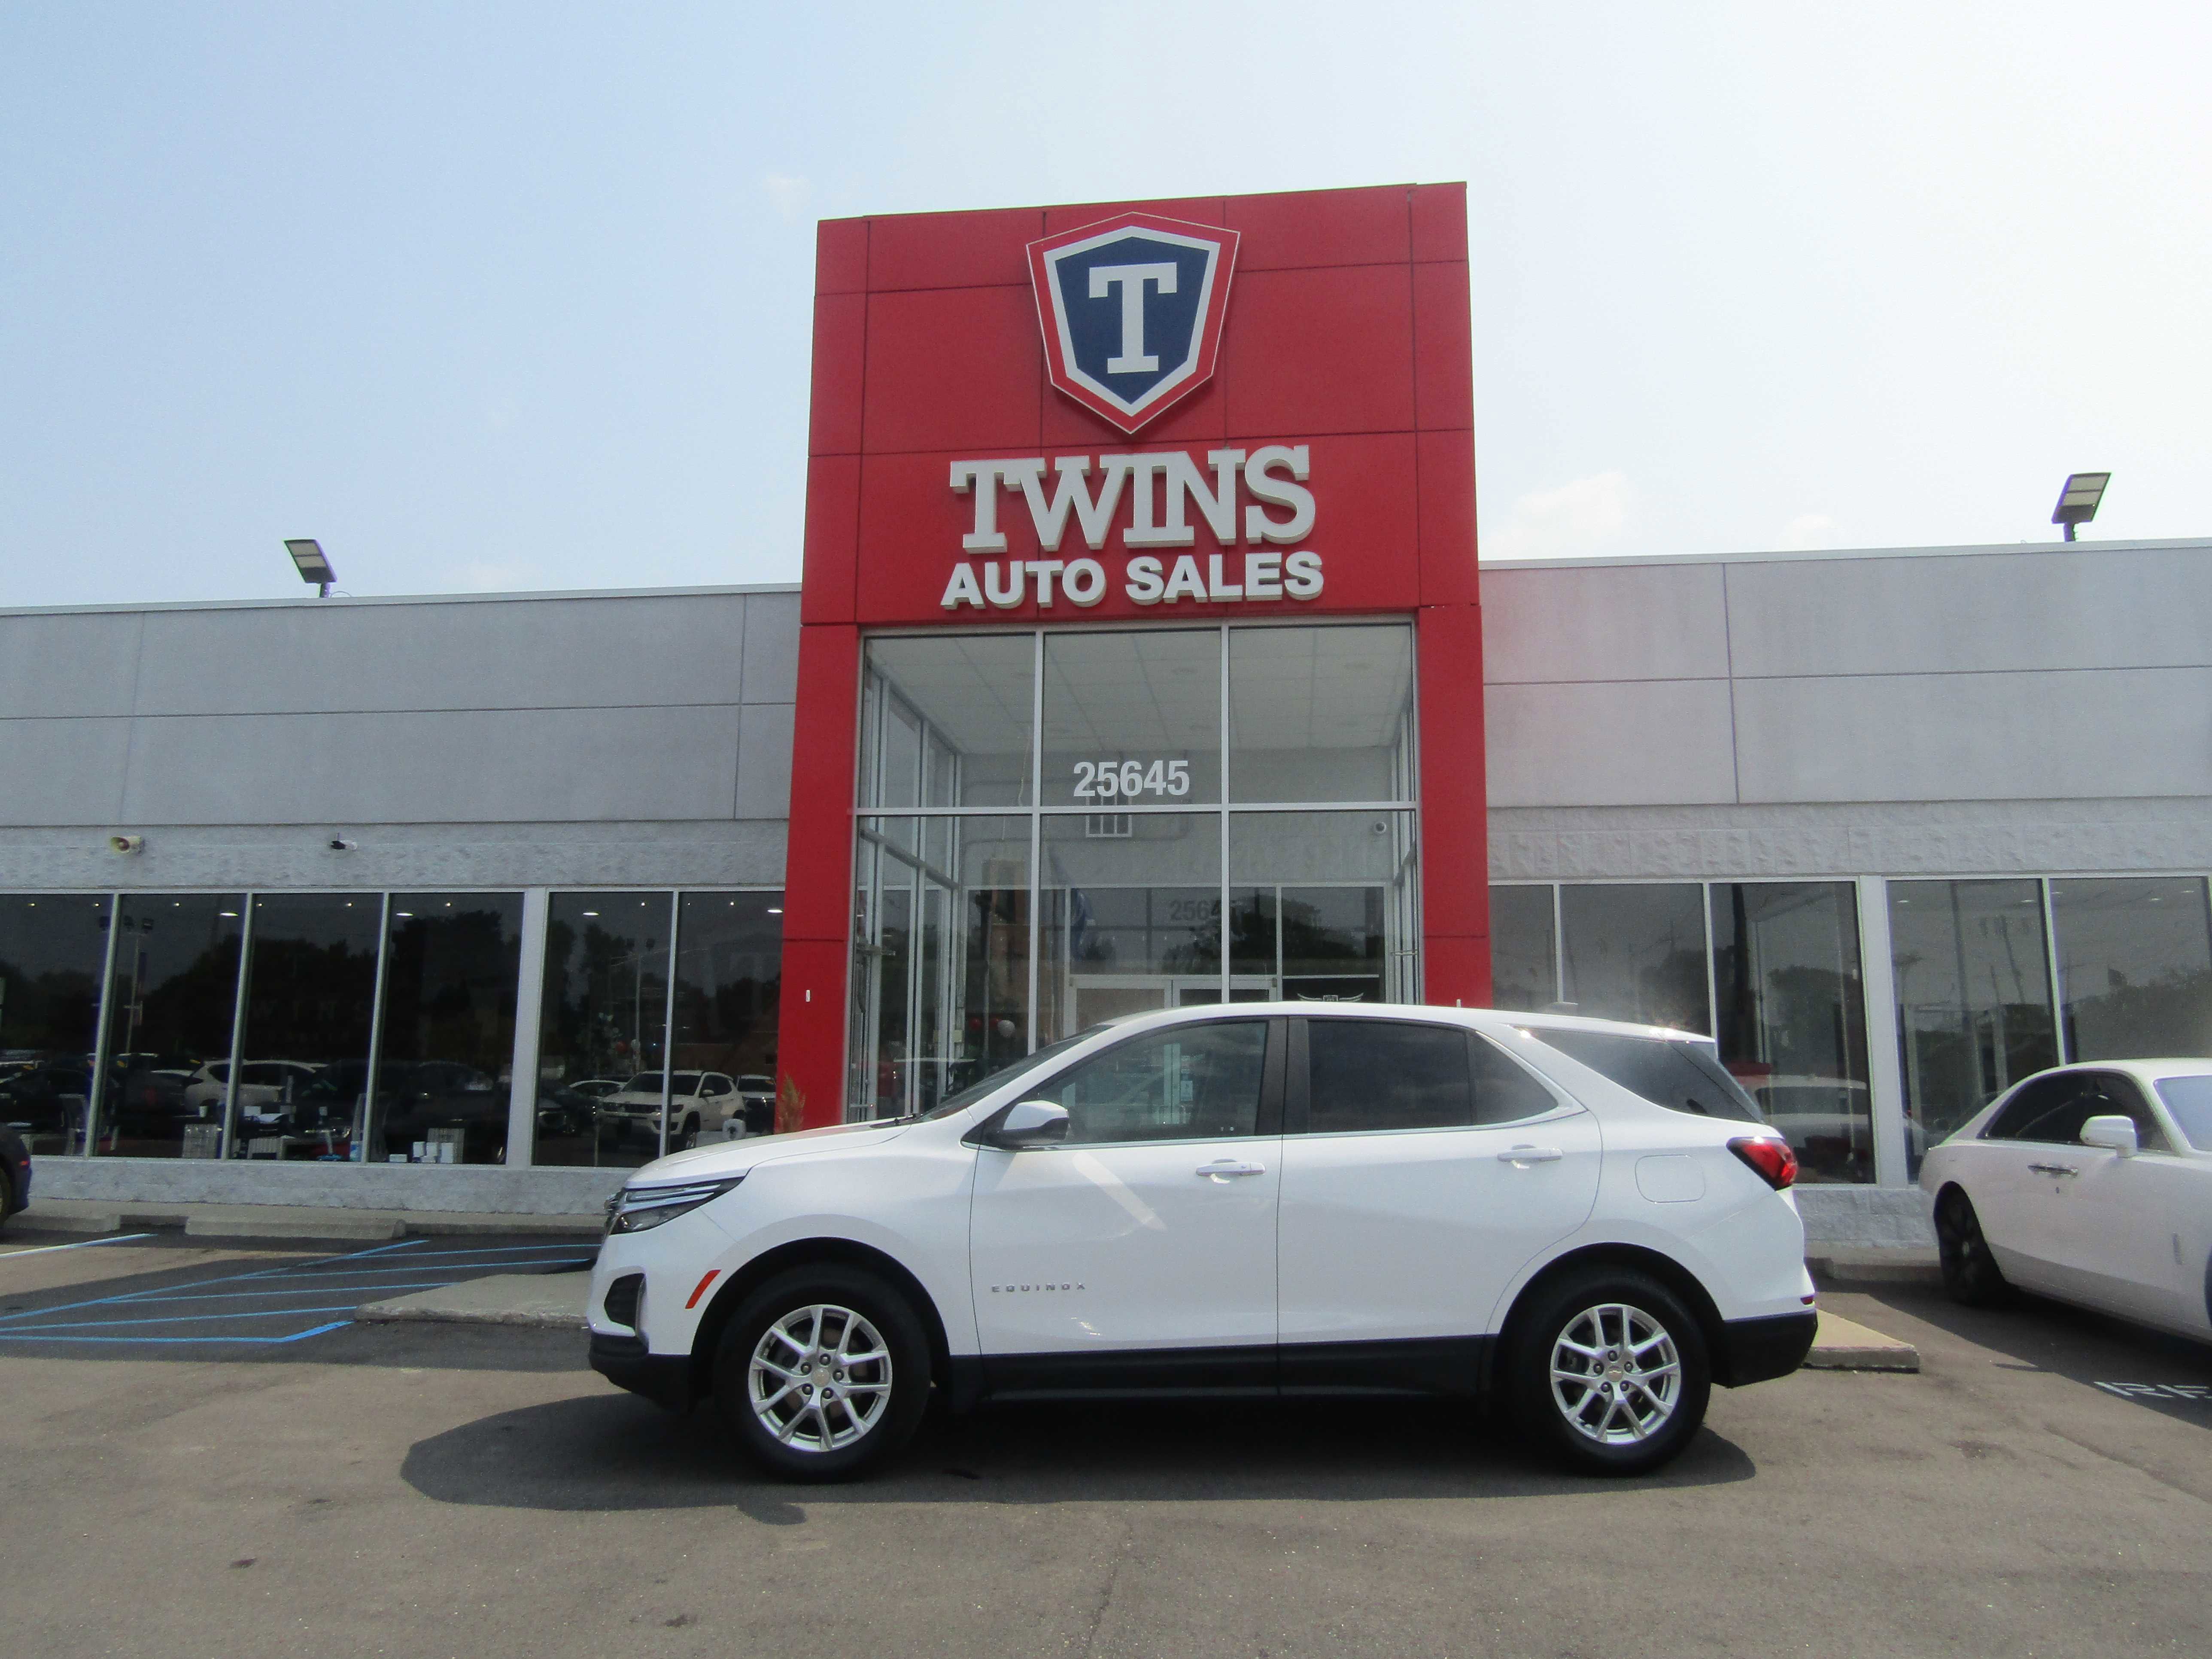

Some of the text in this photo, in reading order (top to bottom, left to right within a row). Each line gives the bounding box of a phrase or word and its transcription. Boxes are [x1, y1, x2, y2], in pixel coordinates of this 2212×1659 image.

[1088, 262, 1177, 374] T
[950, 445, 1316, 554] TWINS
[941, 552, 1324, 610] AUTO SALES
[1073, 760, 1190, 797] 25645
[991, 1282, 1086, 1293] EQUINOX
